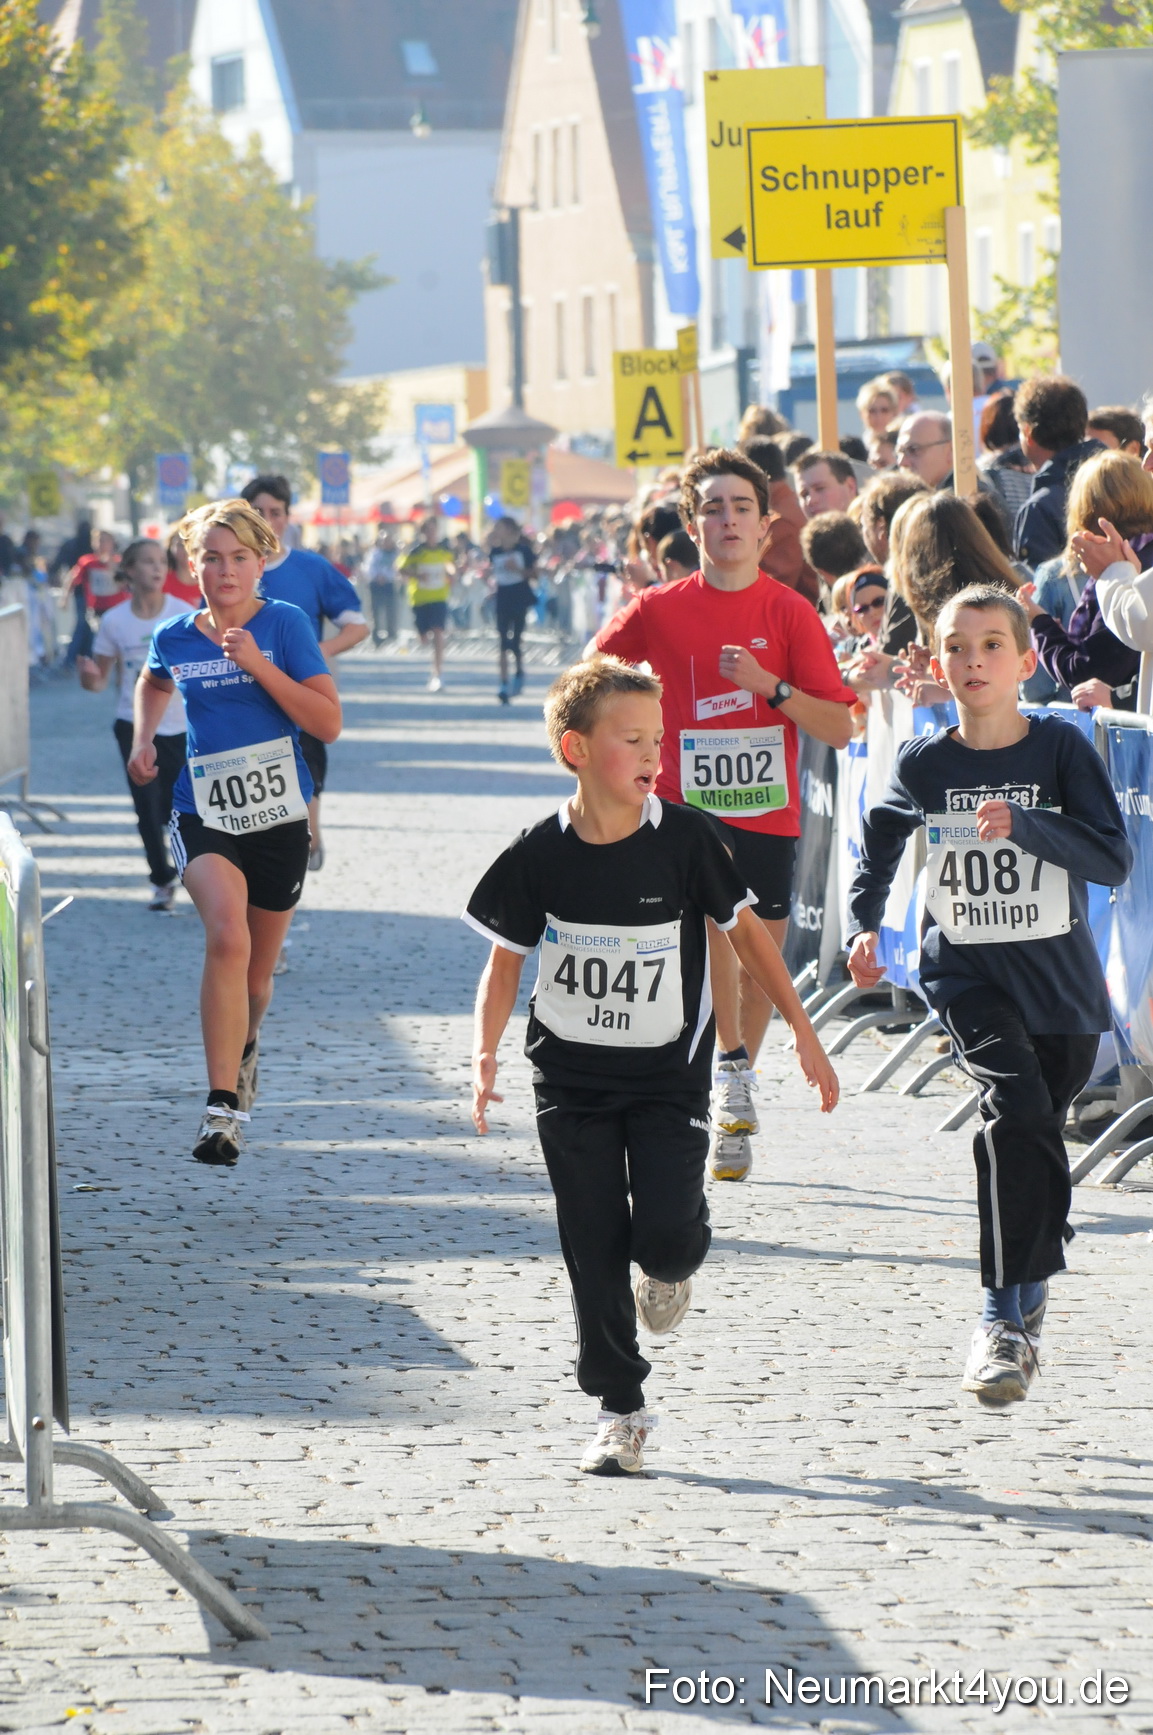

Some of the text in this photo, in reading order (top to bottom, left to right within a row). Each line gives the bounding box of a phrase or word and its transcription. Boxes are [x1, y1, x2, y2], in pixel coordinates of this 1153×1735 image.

[760, 164, 945, 195] Schnupper-
[826, 200, 884, 230] lauf
[620, 354, 680, 377] Block
[633, 385, 674, 441] A
[202, 679, 218, 689] Wir
[221, 676, 240, 687] sind
[711, 697, 738, 711] DEHN
[696, 737, 740, 746] PFLEIDERER
[205, 756, 247, 772] PFLEIDERER
[694, 750, 774, 787] 5002
[208, 764, 287, 812] 4035
[701, 786, 771, 807] Michael
[217, 804, 289, 831] Theresa
[939, 848, 1044, 897] 4087
[952, 900, 1039, 930] Philipp
[560, 931, 621, 948] PFLEIDERER
[554, 953, 666, 1003] 4047
[587, 1004, 631, 1030] Jan
